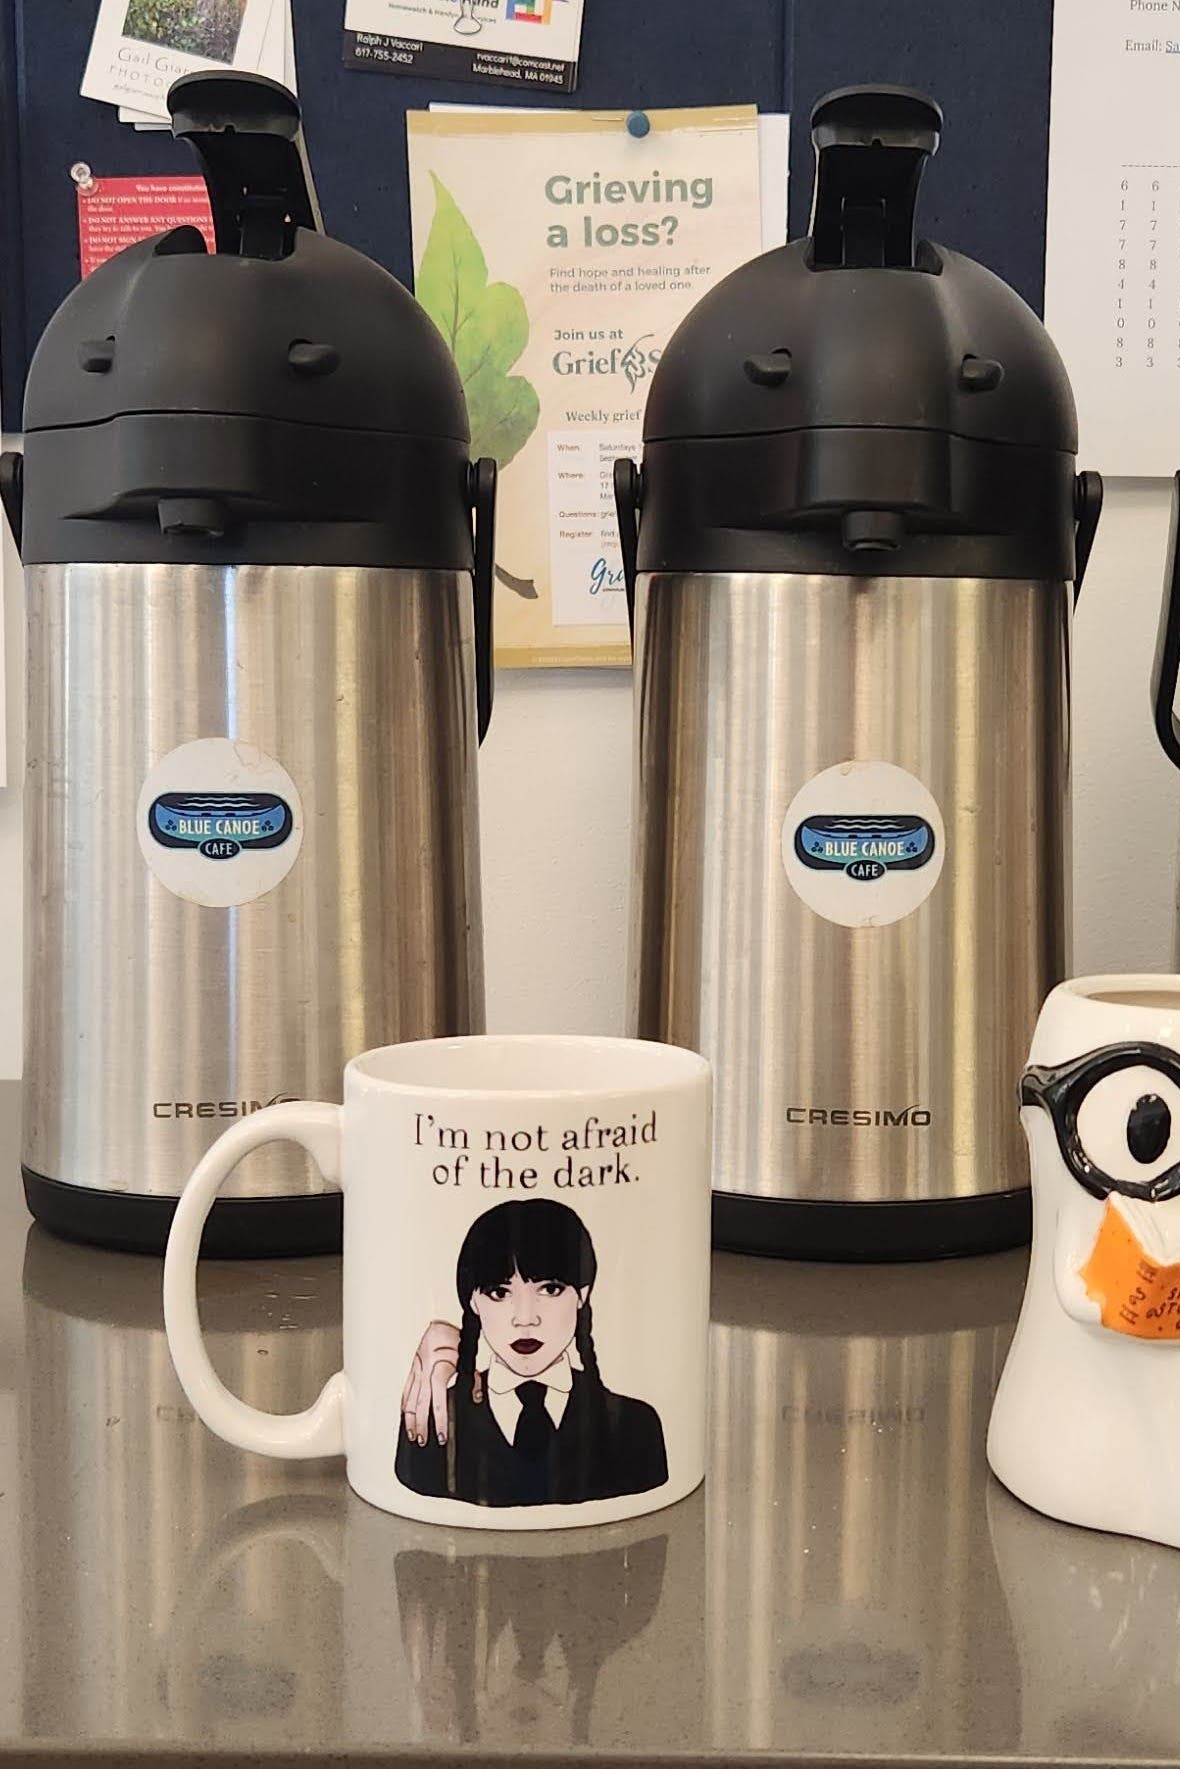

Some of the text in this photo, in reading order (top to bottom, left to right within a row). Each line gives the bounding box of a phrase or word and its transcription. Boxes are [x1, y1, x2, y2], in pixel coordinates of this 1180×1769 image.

[1130, 0, 1168, 11] Phone
[357, 34, 382, 45] Ralph
[1125, 40, 1162, 52] Email:
[544, 170, 712, 209] Grieving
[546, 215, 678, 248] a loss?
[550, 265, 712, 281] Find hope and healing after
[550, 282, 568, 292] the
[573, 282, 606, 292] death
[610, 281, 622, 291] of
[625, 283, 632, 291] a
[635, 280, 666, 290] loved
[554, 329, 623, 340] Join us at
[552, 348, 621, 376] Grief
[566, 409, 642, 424] Weekly grief
[178, 820, 260, 834] BLUE CANOE
[205, 843, 232, 856] CAFE
[825, 842, 905, 856] BLUE CANOE
[851, 864, 878, 876] CAFE
[154, 1099, 300, 1118] CRESI
[786, 1105, 932, 1126] CRESIMO
[485, 1125, 550, 1151] not
[562, 1110, 658, 1150] afraid
[433, 1152, 640, 1188] of the dark.
